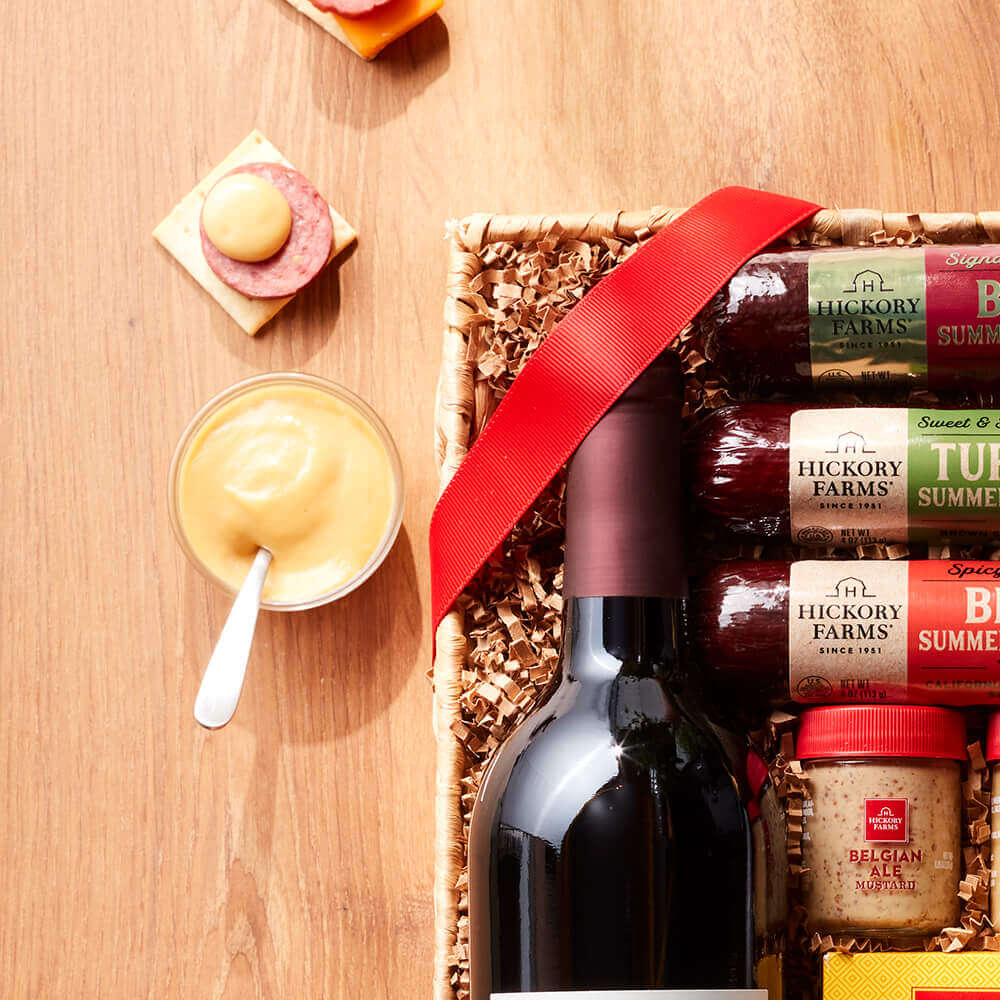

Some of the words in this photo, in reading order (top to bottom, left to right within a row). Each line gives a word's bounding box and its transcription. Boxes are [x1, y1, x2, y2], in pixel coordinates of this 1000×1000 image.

[817, 298, 920, 316] HICKORY
[832, 319, 908, 336] FARMS
[918, 416, 971, 429] Sweet
[977, 416, 990, 428] &
[798, 461, 903, 476] HICKORY
[813, 481, 888, 496] FARMS
[798, 604, 902, 619] HICKORY
[813, 624, 888, 639] FARMS
[850, 849, 922, 863] BELGIAN
[870, 864, 902, 878] ALE
[856, 880, 915, 890] MUSTARD
